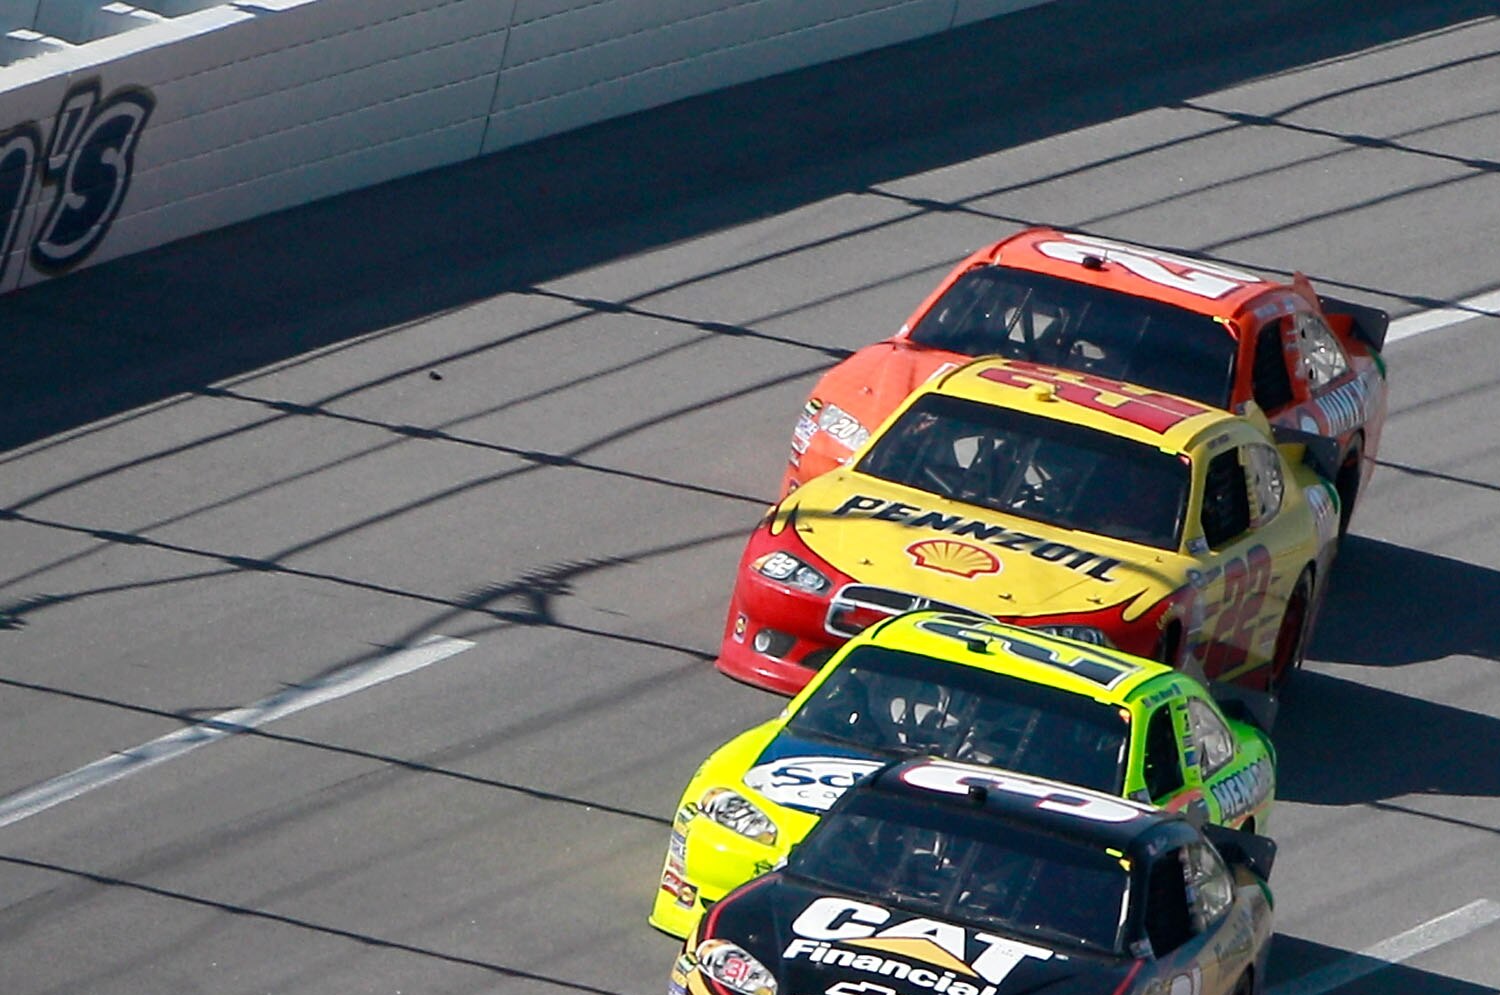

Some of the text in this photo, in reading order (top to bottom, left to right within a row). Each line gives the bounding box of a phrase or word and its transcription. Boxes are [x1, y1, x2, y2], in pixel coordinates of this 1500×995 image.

[826, 417, 860, 440] 20
[832, 495, 1121, 582] PENNZOIL
[792, 896, 1055, 985] CAT
[723, 956, 751, 982] 31
